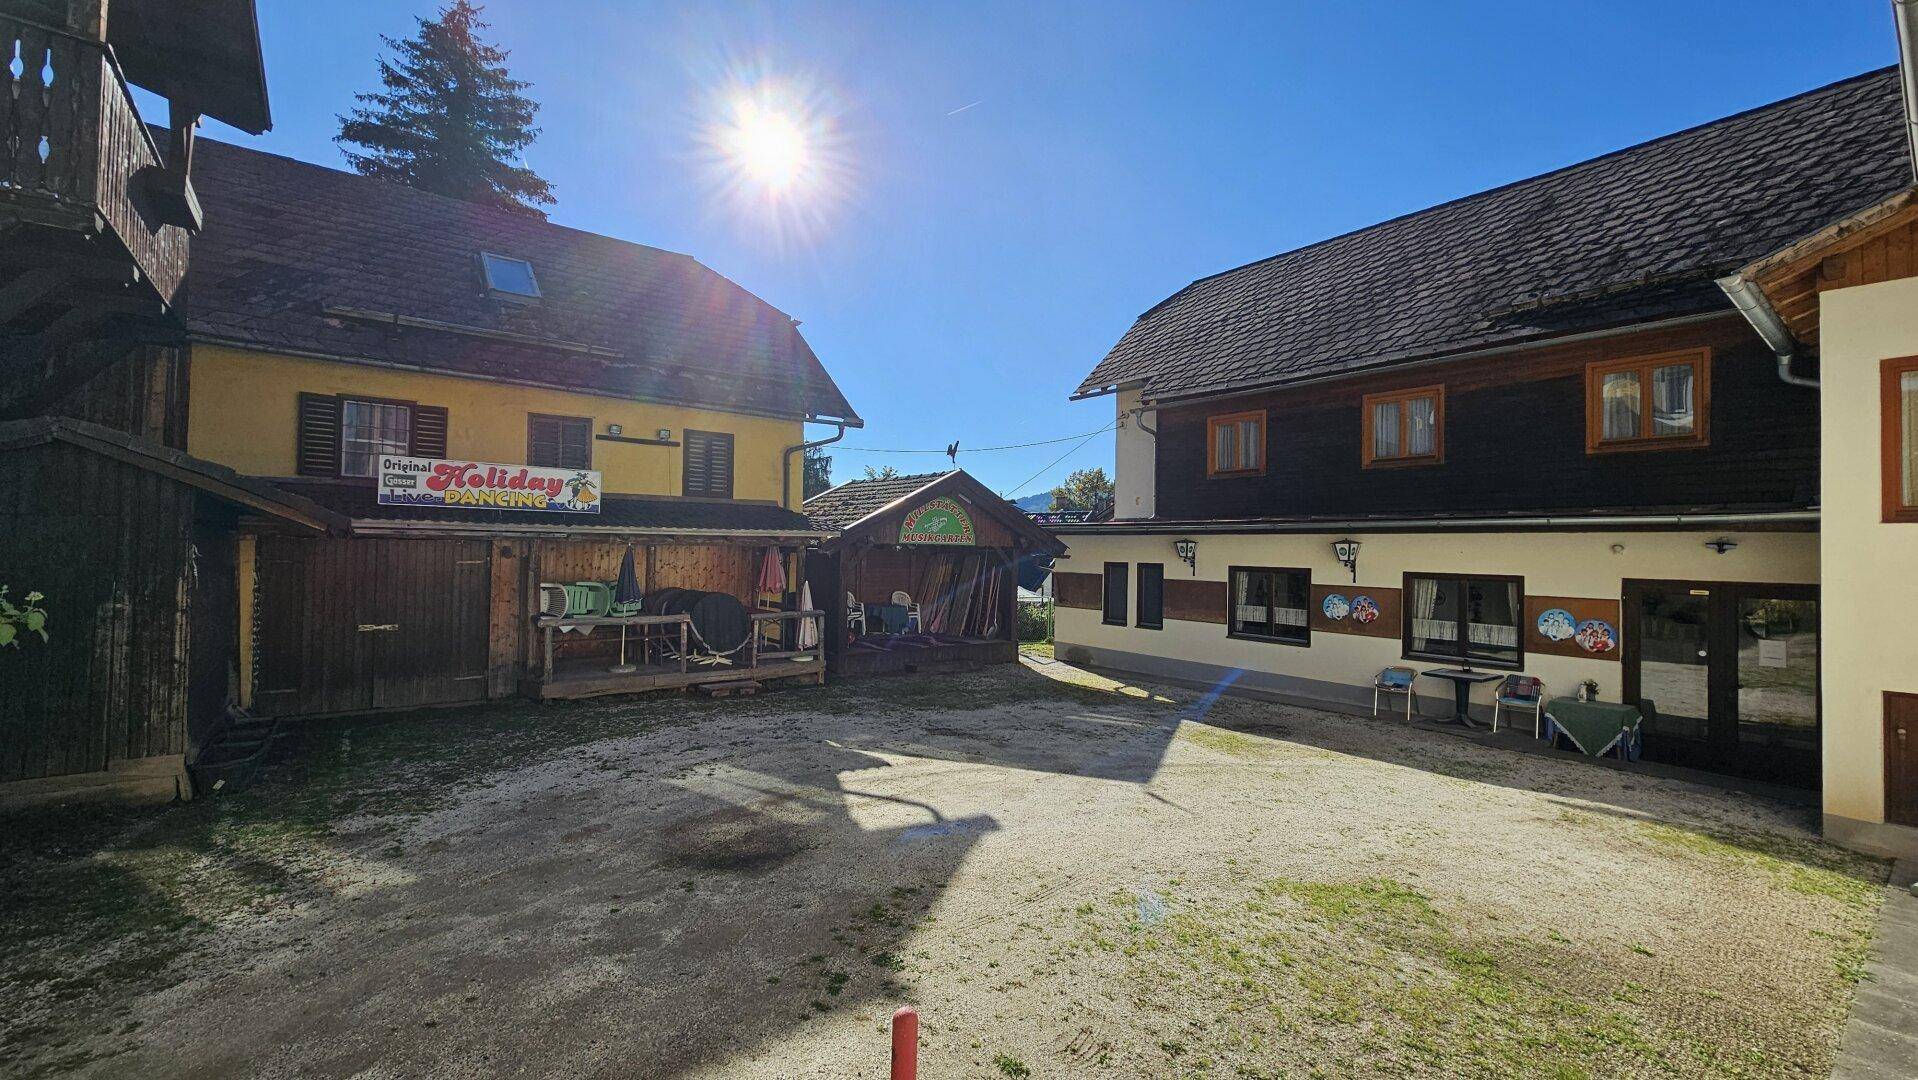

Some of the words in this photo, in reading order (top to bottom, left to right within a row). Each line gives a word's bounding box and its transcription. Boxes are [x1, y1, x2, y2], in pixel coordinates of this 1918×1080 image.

[383, 459, 431, 473] Original
[426, 463, 564, 497] Holiday
[444, 489, 547, 508] DANCING
[902, 533, 973, 544] MUSIKGARTEN
